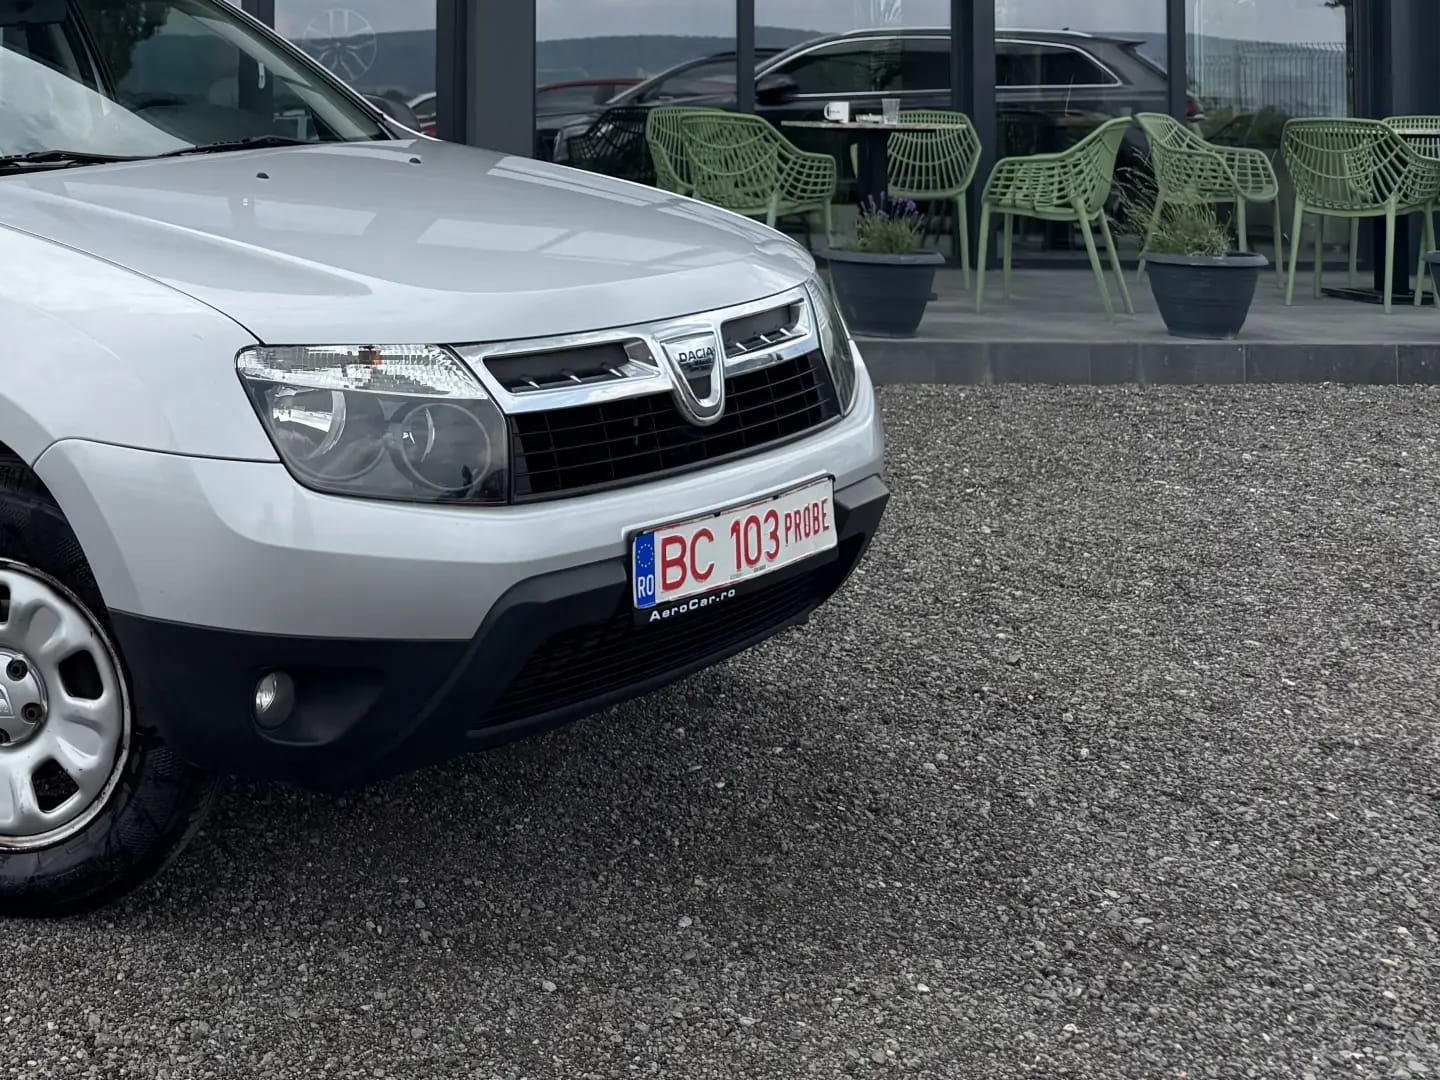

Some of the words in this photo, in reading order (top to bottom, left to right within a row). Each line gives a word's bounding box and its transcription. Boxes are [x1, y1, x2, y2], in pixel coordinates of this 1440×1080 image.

[678, 346, 714, 363] DACIA
[661, 528, 714, 592] BC
[730, 509, 780, 571] 103
[784, 498, 830, 545] PROBE
[637, 574, 655, 599] RO
[649, 588, 736, 622] AeroCar.ro
